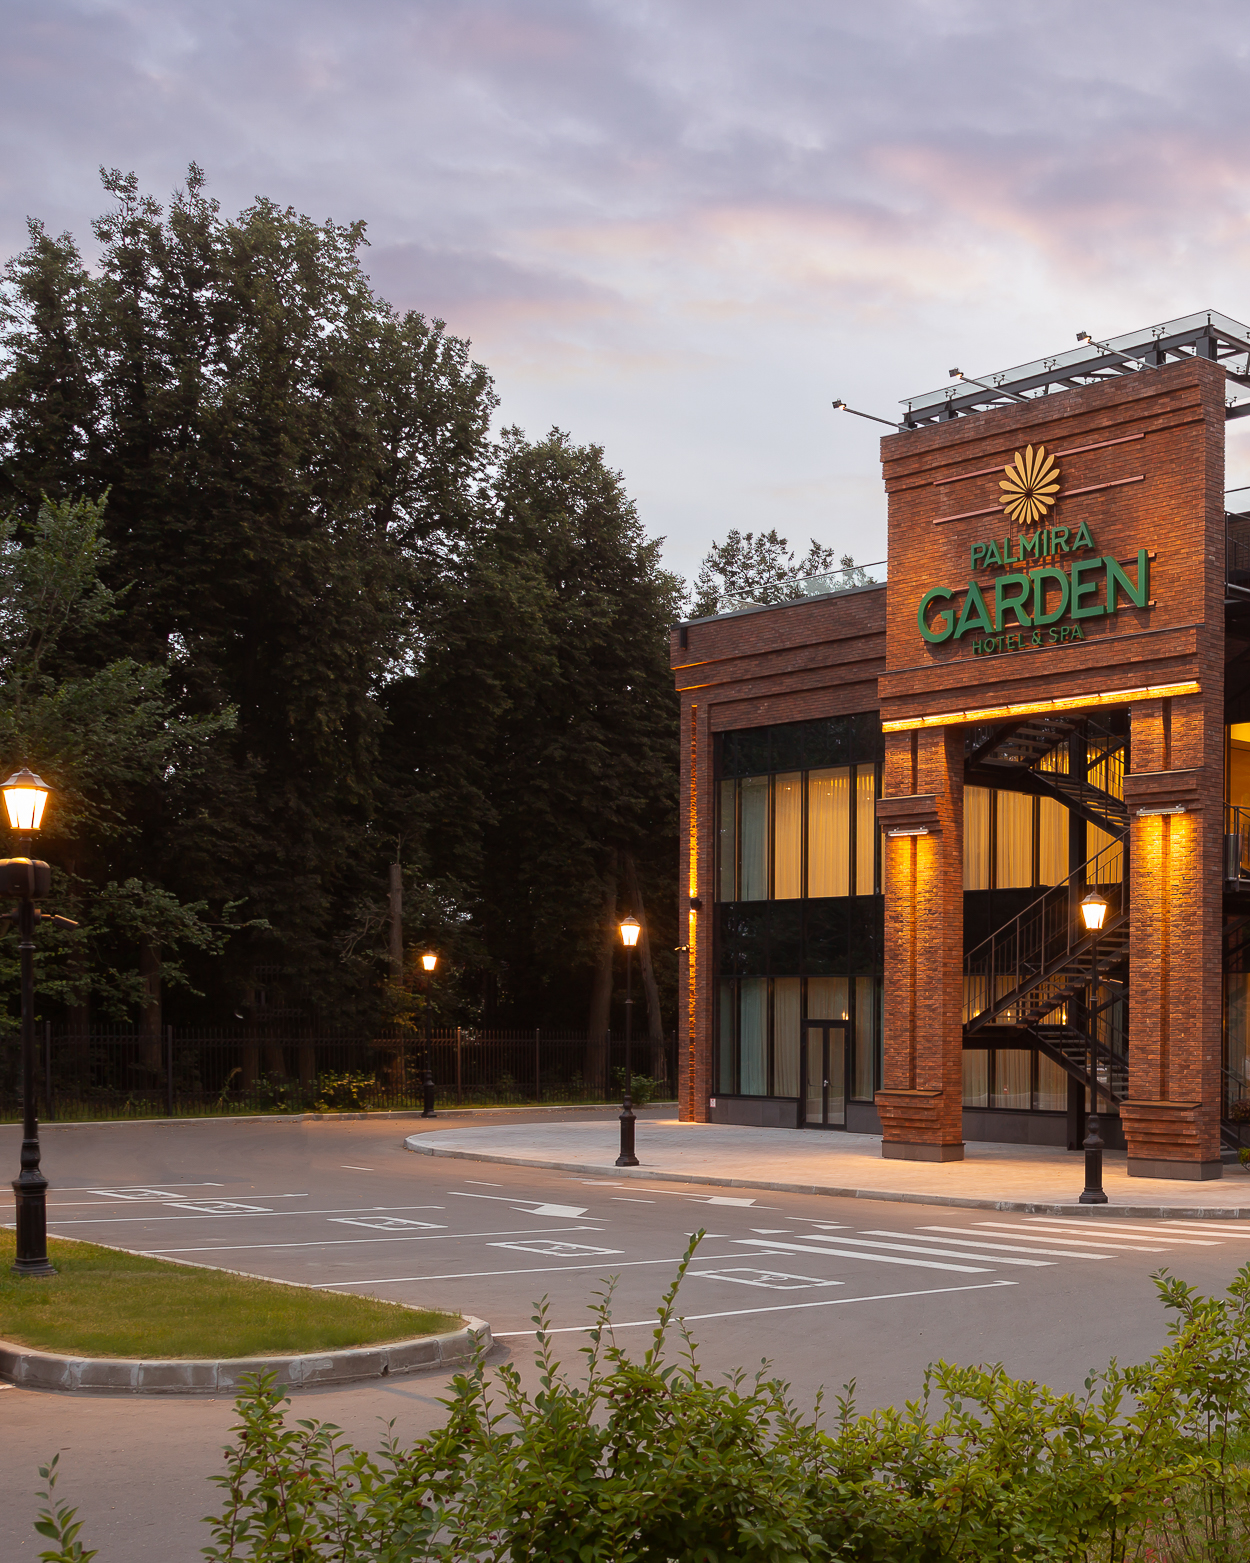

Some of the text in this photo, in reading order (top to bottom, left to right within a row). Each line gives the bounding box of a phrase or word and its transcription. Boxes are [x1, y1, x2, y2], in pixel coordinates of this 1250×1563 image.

[971, 522, 1095, 570] PALMIRA
[917, 549, 1149, 643] GARDEN
[972, 624, 1084, 655] HOTEL & SPA
